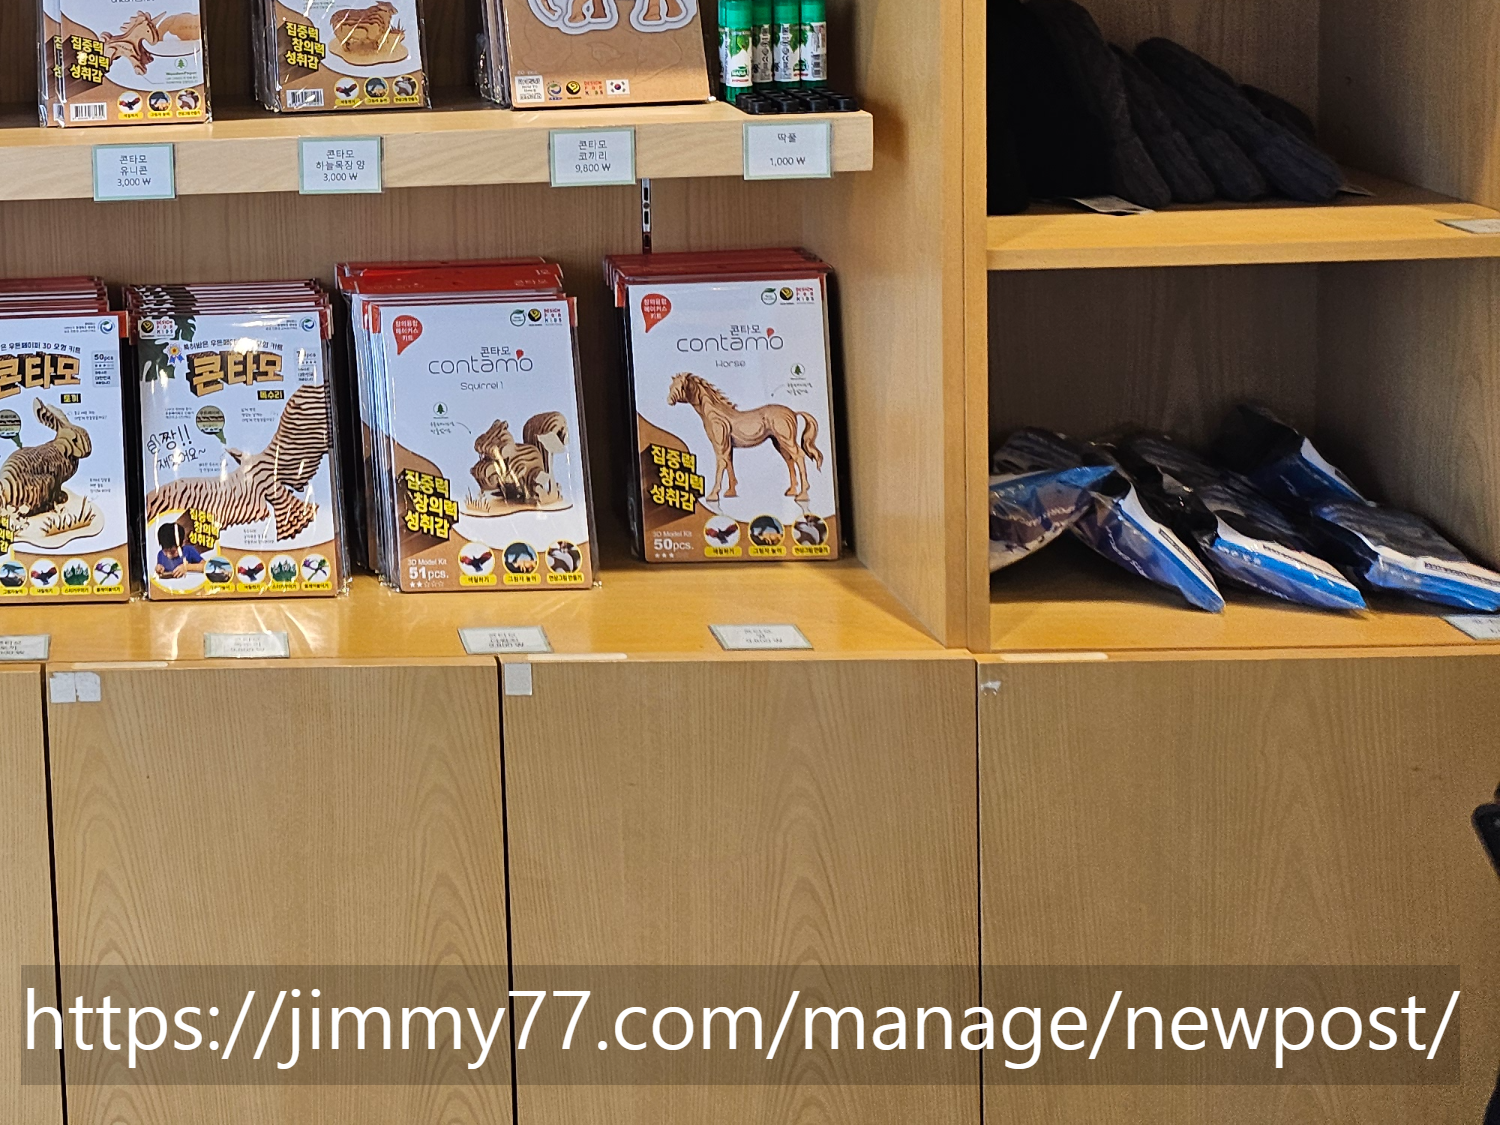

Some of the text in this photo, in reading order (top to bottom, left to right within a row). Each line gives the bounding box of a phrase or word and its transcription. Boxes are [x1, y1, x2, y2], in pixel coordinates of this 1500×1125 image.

[285, 22, 320, 42] 집중력
[70, 35, 104, 54] 집중력
[291, 37, 326, 58] 창의력
[76, 50, 110, 70] 창의력
[285, 51, 320, 70] 성취감
[69, 64, 103, 84] 성취감
[778, 132, 797, 143] 딱풀
[578, 139, 607, 151] 콘타모
[119, 154, 147, 165] 콘타모
[326, 149, 355, 160] 콘타모
[578, 150, 607, 162] 코끼리
[315, 159, 365, 172] 하늘목장 양
[575, 162, 600, 173] 9,800
[770, 157, 794, 167] 1,000
[119, 166, 147, 177] 유니콘
[323, 172, 347, 183] 3,000
[117, 177, 141, 188] 3,000
[650, 312, 662, 320] 키트
[729, 324, 761, 336] 콘타모
[42, 342, 52, 350] 3D
[53, 343, 67, 352] 모형
[68, 345, 81, 354] 키트
[184, 340, 209, 350] 특허받은
[676, 334, 784, 353] contamo
[94, 353, 114, 362] 50pcs
[480, 346, 511, 357] 콘타모
[428, 355, 533, 374] contamo
[715, 359, 746, 368] Horse
[186, 350, 284, 398] 콘타모
[460, 382, 499, 392] Squirrel
[158, 424, 192, 451] 짱!!
[651, 444, 696, 473] 집중력
[404, 469, 450, 498] 집중력
[659, 467, 704, 495] 창의력
[650, 484, 696, 512] 성취감
[413, 492, 458, 521] 창의력
[404, 509, 450, 539] 성취감
[188, 531, 215, 548] 성취감
[653, 539, 694, 553] 50pcs.
[409, 567, 449, 581] 51pcs.
